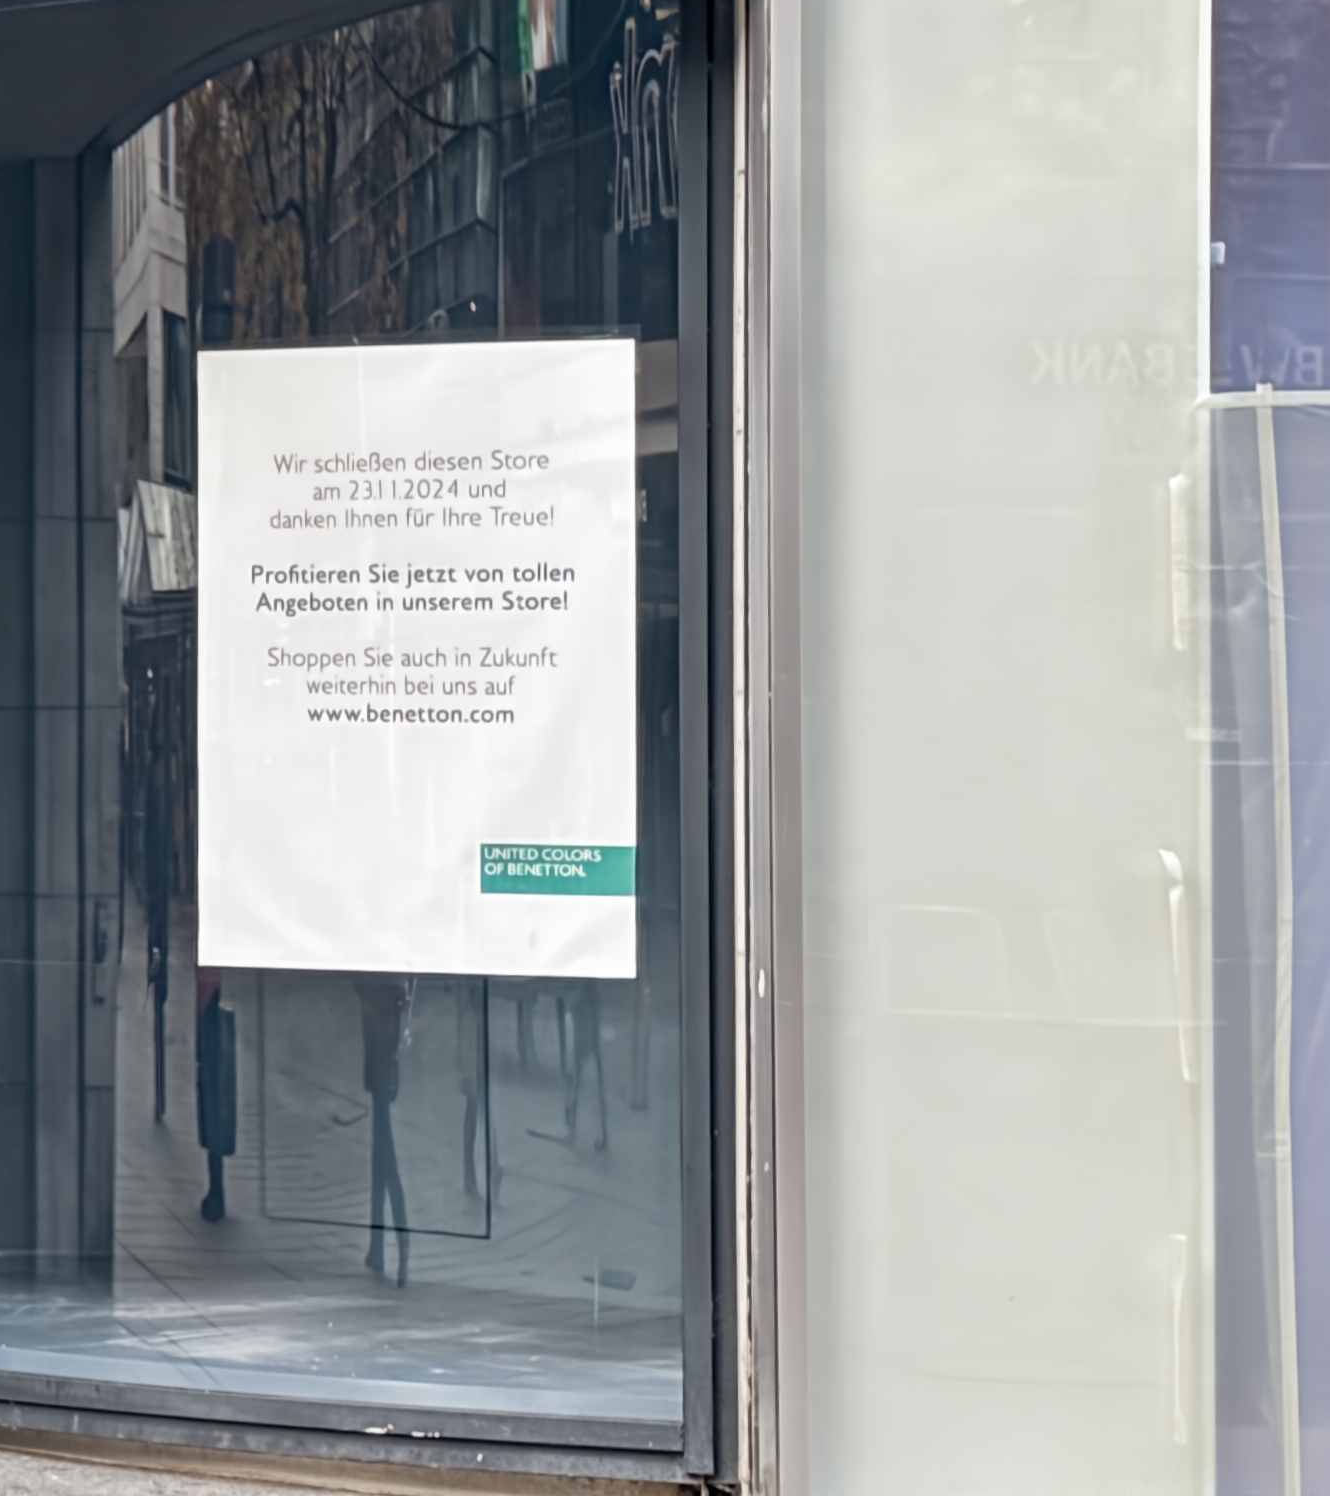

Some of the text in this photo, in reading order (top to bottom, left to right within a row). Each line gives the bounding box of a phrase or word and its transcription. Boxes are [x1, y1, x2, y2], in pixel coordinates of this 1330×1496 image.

[273, 450, 550, 474] Wir schließen diesen Store
[312, 478, 506, 501] am 23.11.2024 und
[270, 505, 554, 529] danken Ihnen für Ihre Treue!
[251, 562, 576, 589] Profitieren Sie jetzt von tollen
[255, 590, 569, 616] Angeboten in unserem Store!
[267, 646, 558, 672] Shoppen Sie auch in Zukunft
[306, 675, 517, 696] weiterhin bei uns auf
[308, 704, 514, 725] www.benetton.com
[484, 847, 602, 862] UNITED COLORS
[484, 863, 504, 876] OF
